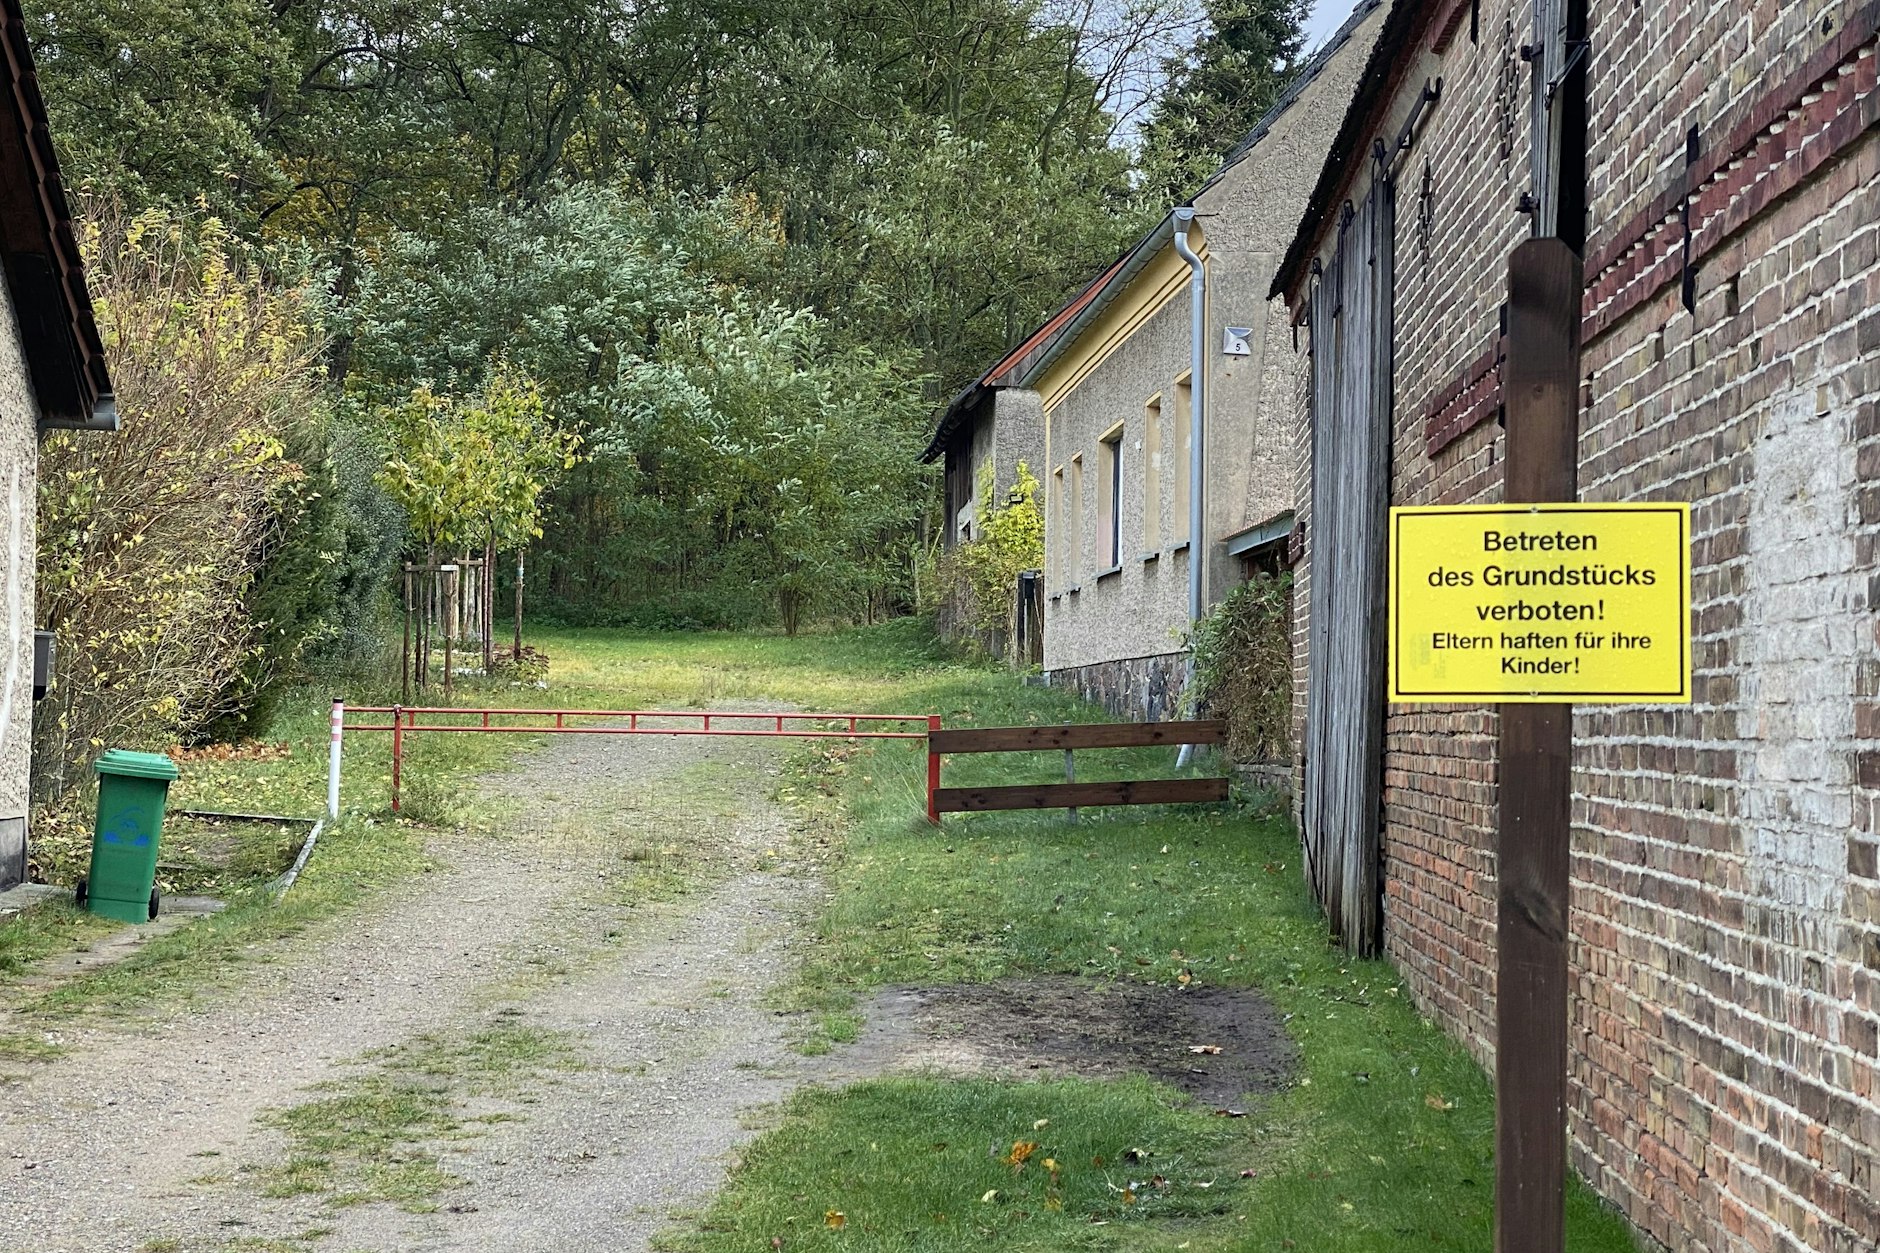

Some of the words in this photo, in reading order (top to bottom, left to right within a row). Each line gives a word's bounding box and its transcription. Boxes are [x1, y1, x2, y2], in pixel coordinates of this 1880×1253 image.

[1235, 342, 1241, 352] 5
[1484, 530, 1597, 551] Betreten
[1427, 566, 1474, 587] des
[1482, 564, 1656, 587] Grundstücks
[1476, 599, 1604, 621] verboten!
[1432, 632, 1493, 650] Eltern
[1500, 631, 1568, 650] haften
[1574, 631, 1605, 649] für
[1611, 631, 1652, 649] ihre
[1501, 656, 1580, 674] Kinder!
